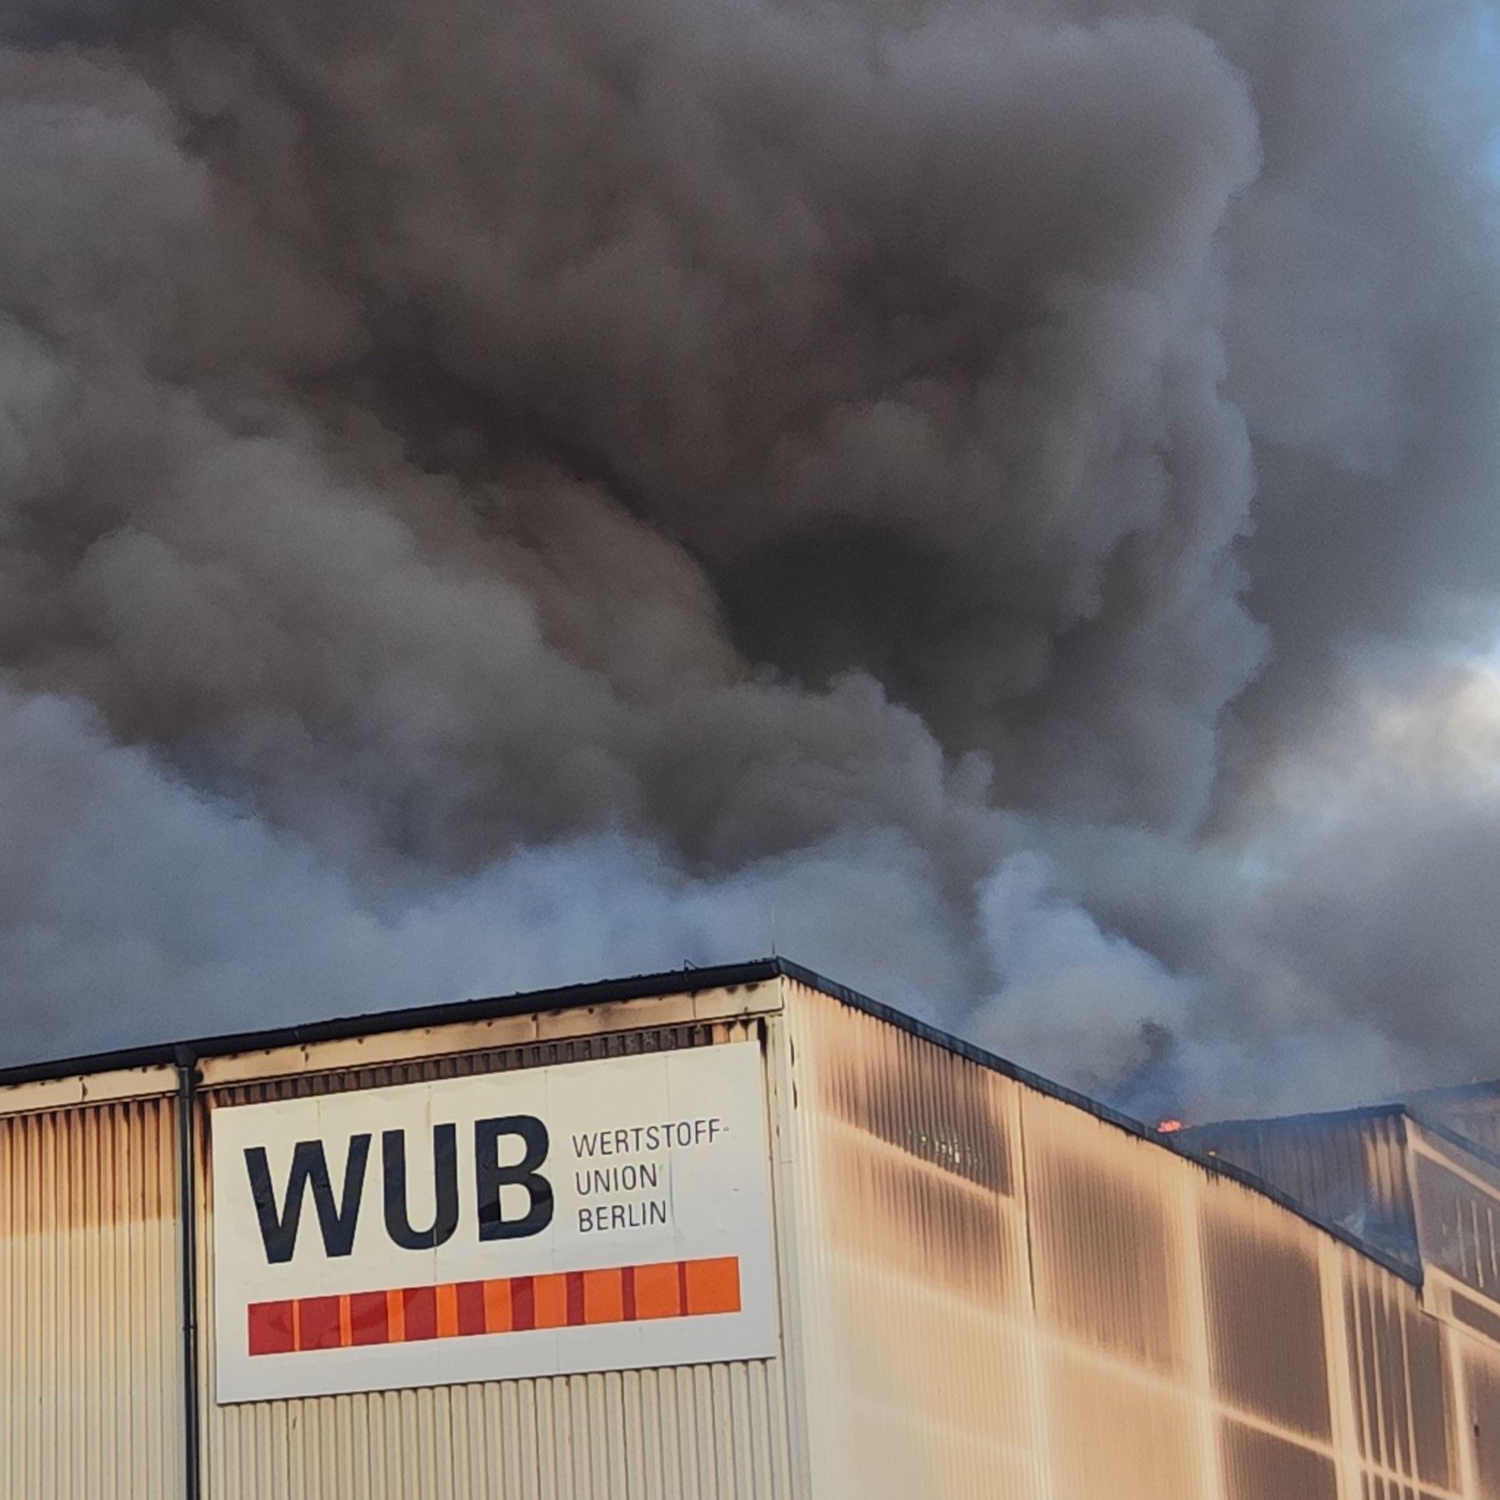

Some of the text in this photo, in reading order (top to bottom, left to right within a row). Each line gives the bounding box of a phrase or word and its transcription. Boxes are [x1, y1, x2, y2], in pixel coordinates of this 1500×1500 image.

[243, 1114, 555, 1265] WUB
[575, 1162, 659, 1196] UNION
[577, 1199, 668, 1234] BERLIN
